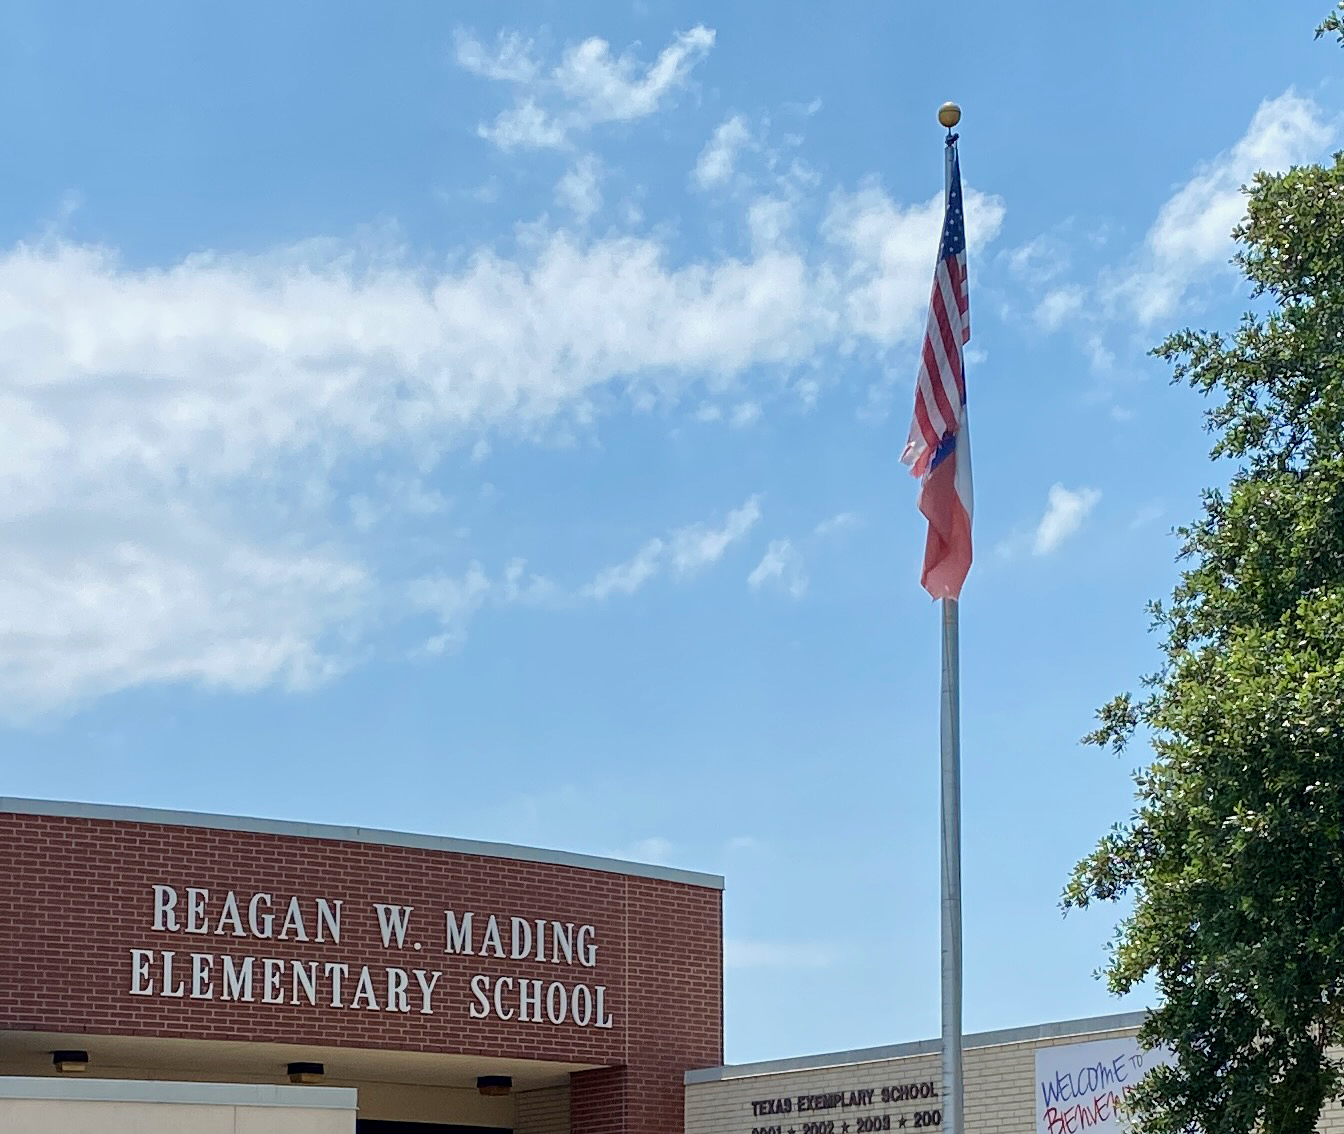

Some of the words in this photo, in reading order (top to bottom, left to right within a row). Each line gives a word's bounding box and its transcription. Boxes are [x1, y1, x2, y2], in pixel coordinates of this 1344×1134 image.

[151, 884, 343, 944] REAGAN
[372, 903, 422, 951] W.
[444, 910, 597, 968] MADING
[128, 948, 443, 1015] ELEMENTARY
[470, 974, 614, 1029] SCHOOL
[752, 1098, 792, 1116] TEXAS
[797, 1088, 875, 1112] EXEMPLARY
[881, 1082, 938, 1103] SCHOOL
[1042, 1054, 1128, 1107] WELCOME
[1128, 1054, 1144, 1070] TO
[857, 1114, 890, 1133] 2003
[914, 1110, 942, 1128] 200
